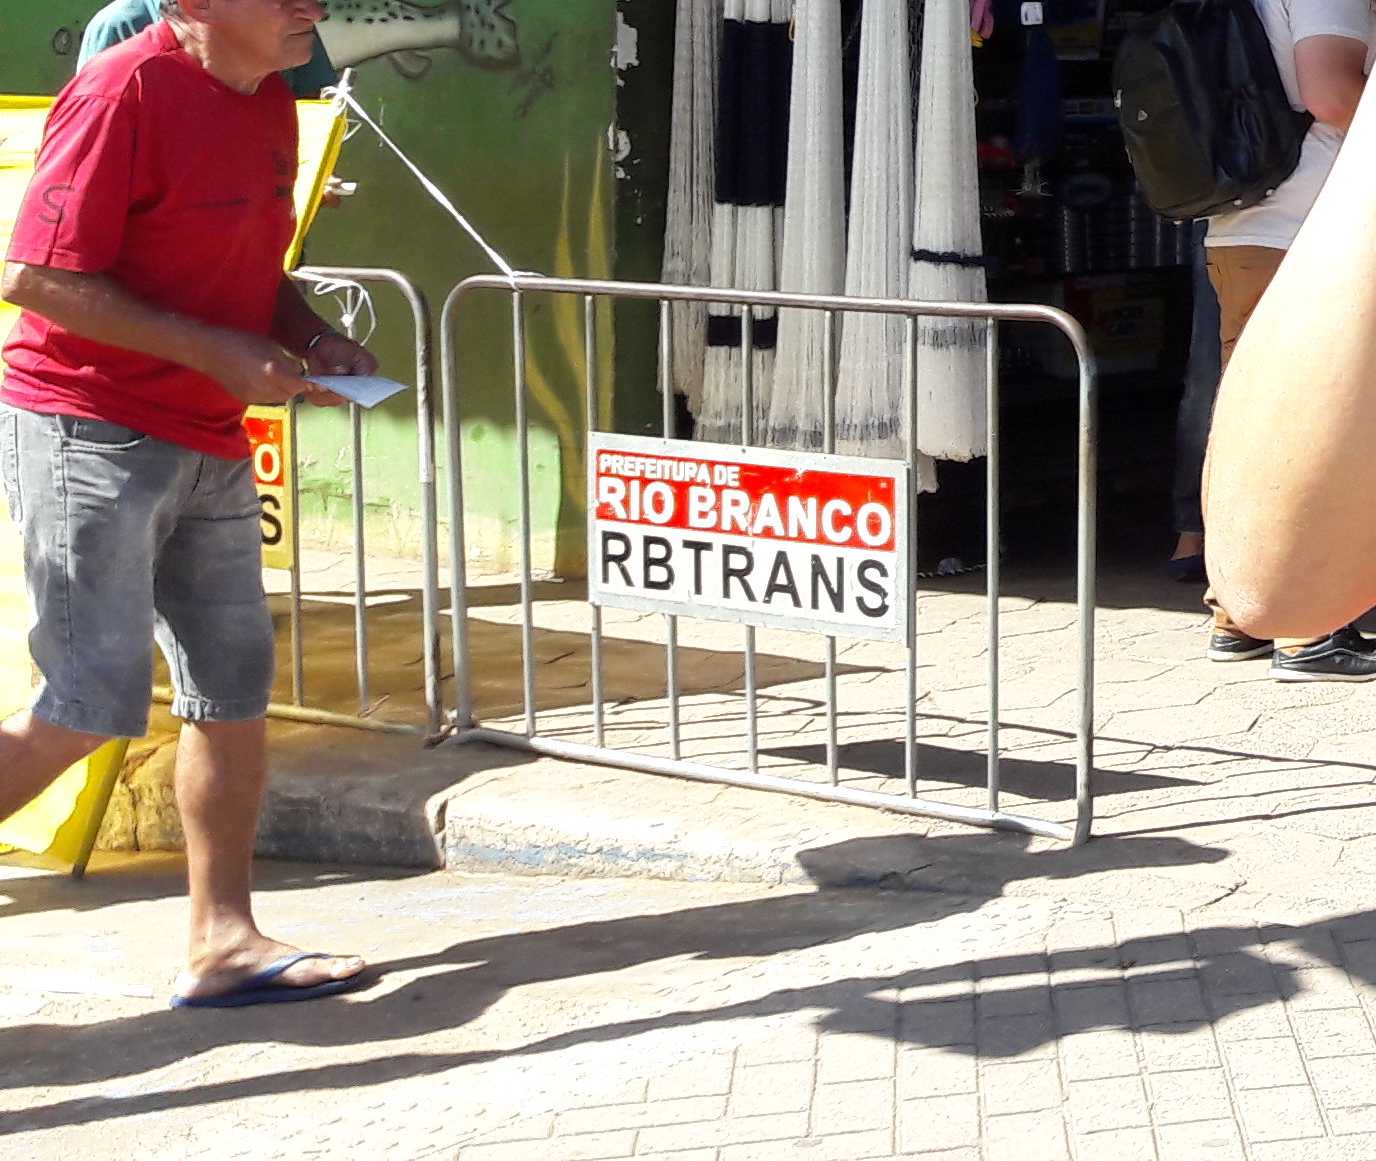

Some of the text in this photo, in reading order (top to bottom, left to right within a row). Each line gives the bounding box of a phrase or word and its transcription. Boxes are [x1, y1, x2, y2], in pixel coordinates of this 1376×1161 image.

[598, 453, 741, 488] PREFEITURA DE
[597, 476, 892, 547] RIO BRANCO
[601, 529, 890, 619] RBTRANS
